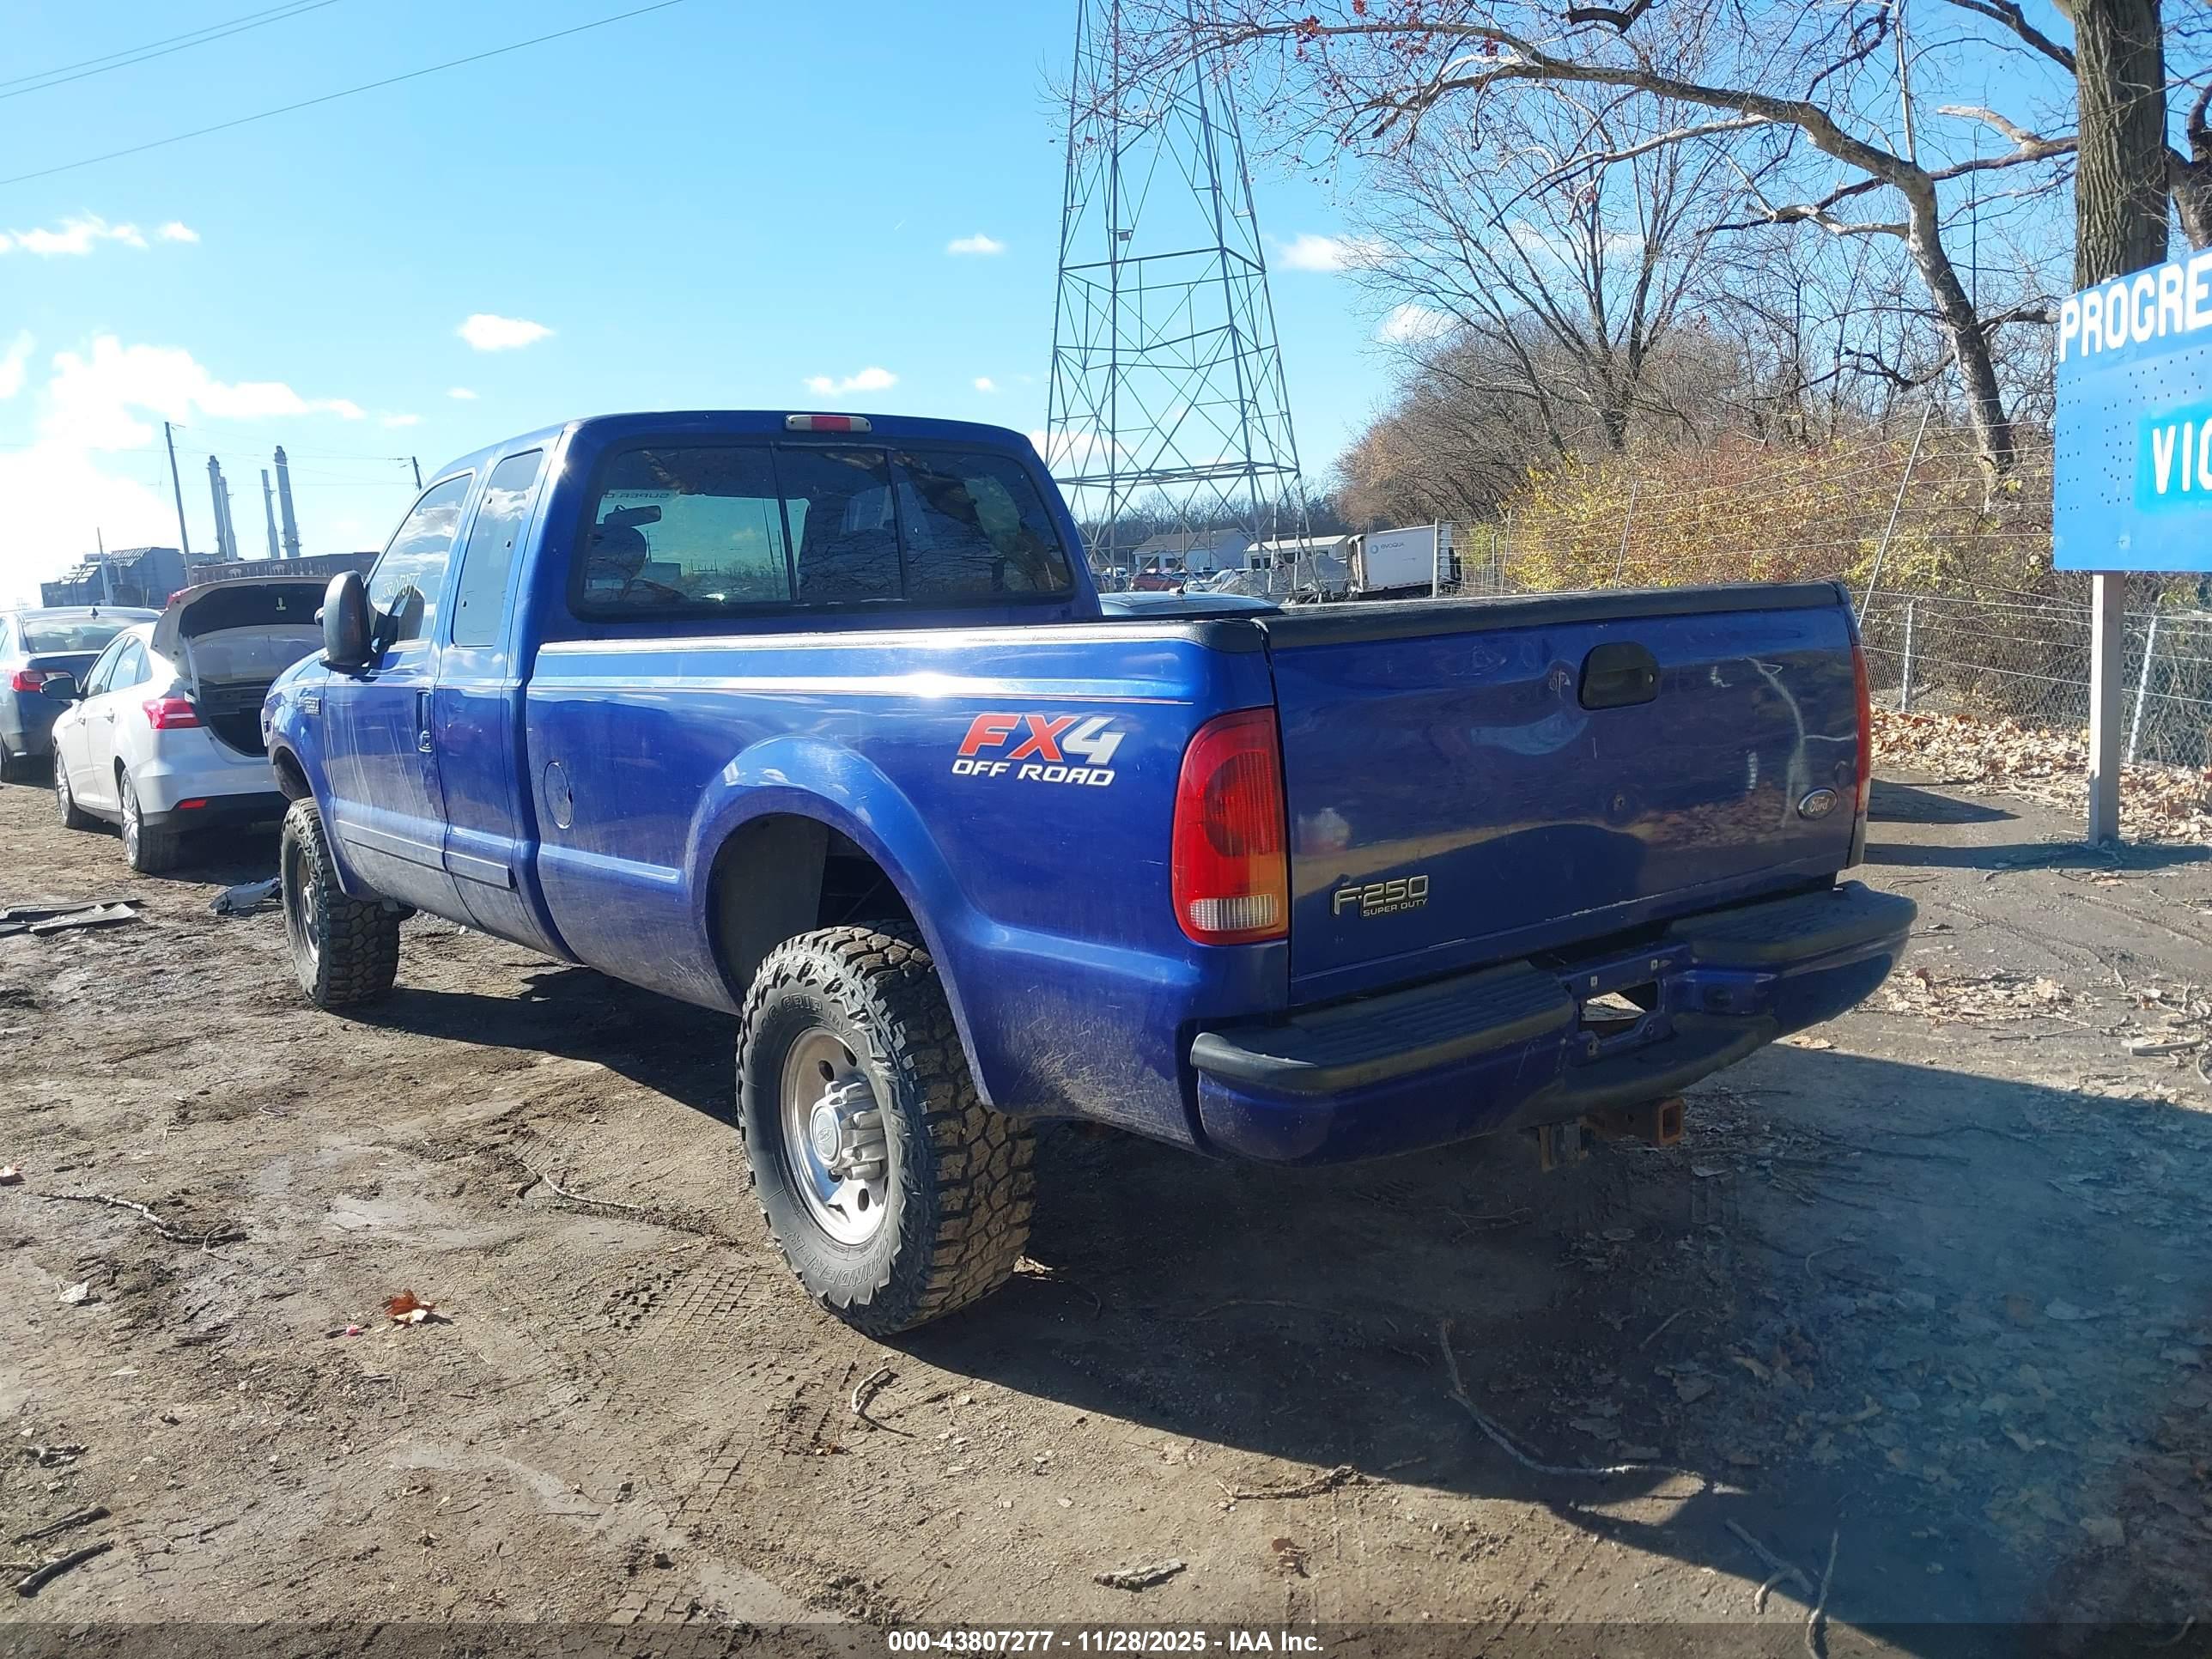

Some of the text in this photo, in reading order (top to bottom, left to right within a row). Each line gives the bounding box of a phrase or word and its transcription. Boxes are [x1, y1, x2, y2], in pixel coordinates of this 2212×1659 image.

[957, 711, 1127, 766] FX4
[951, 758, 1116, 787] OFF ROAD
[1334, 874, 1430, 916] F-250
[1362, 897, 1429, 917] SUPER DUTY
[781, 994, 823, 1012] GRIP
